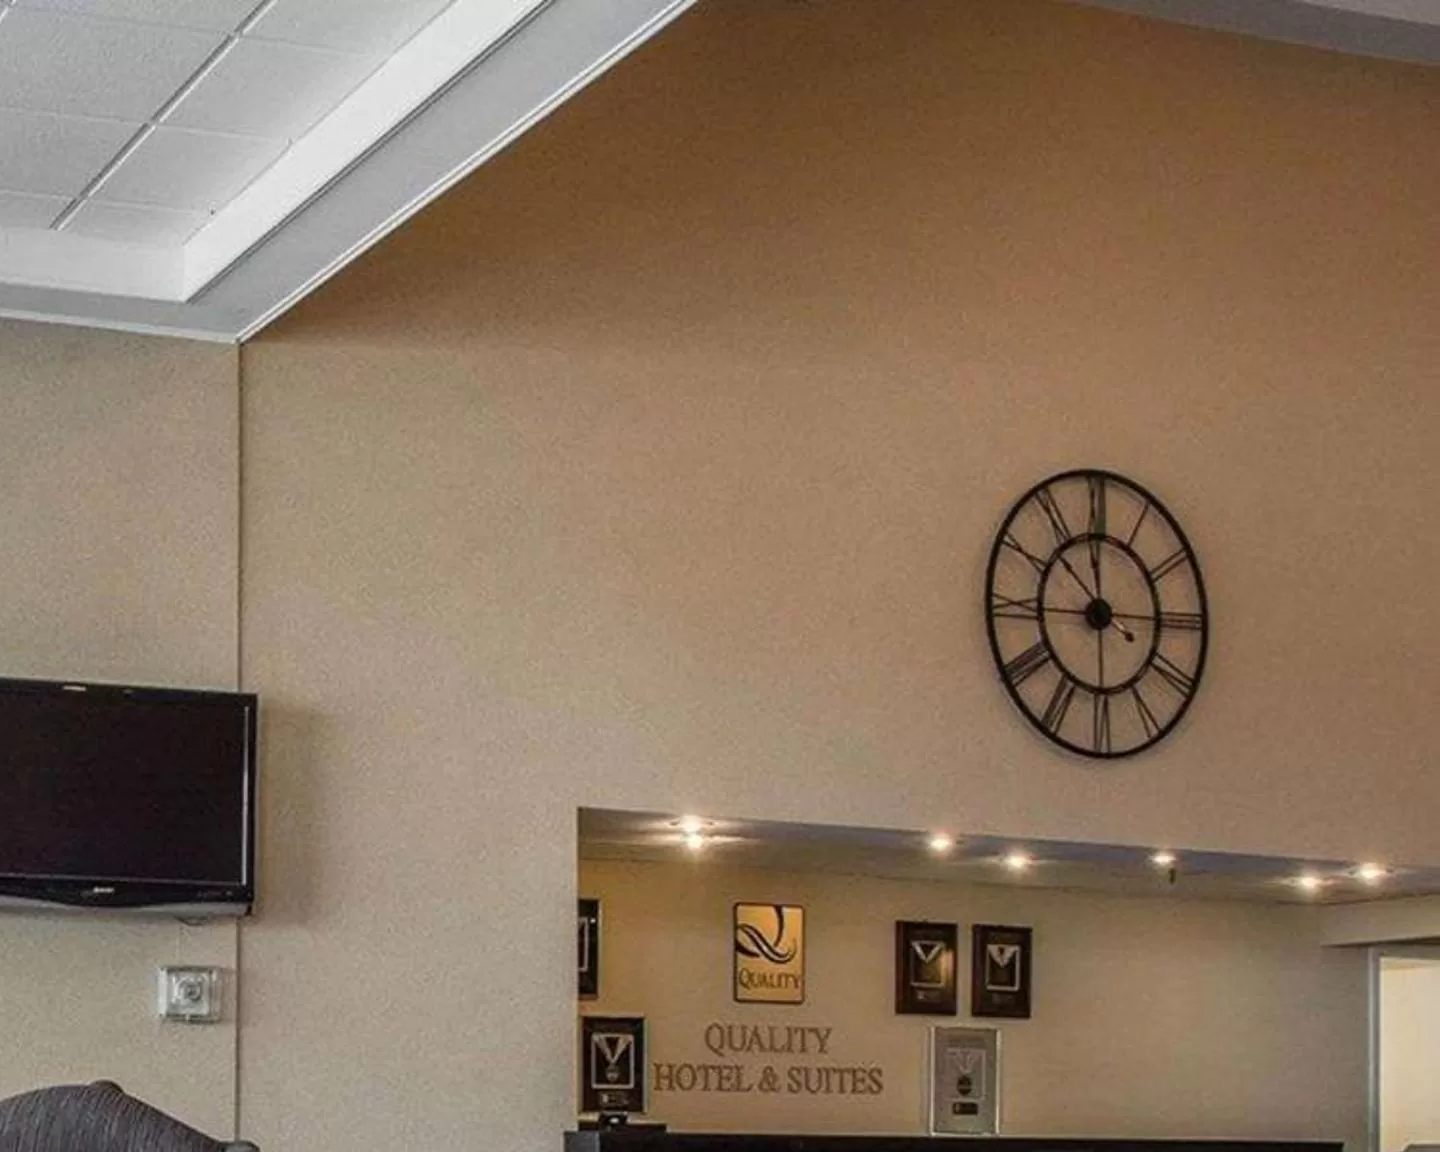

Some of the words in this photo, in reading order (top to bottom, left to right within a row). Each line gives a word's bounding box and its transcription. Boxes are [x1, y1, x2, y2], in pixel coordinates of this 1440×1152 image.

[738, 967, 803, 991] QUALITY
[704, 1022, 832, 1057] QUALITY
[653, 1063, 754, 1093] HOTEL
[757, 1065, 781, 1092] &
[786, 1065, 885, 1095] SUITES
